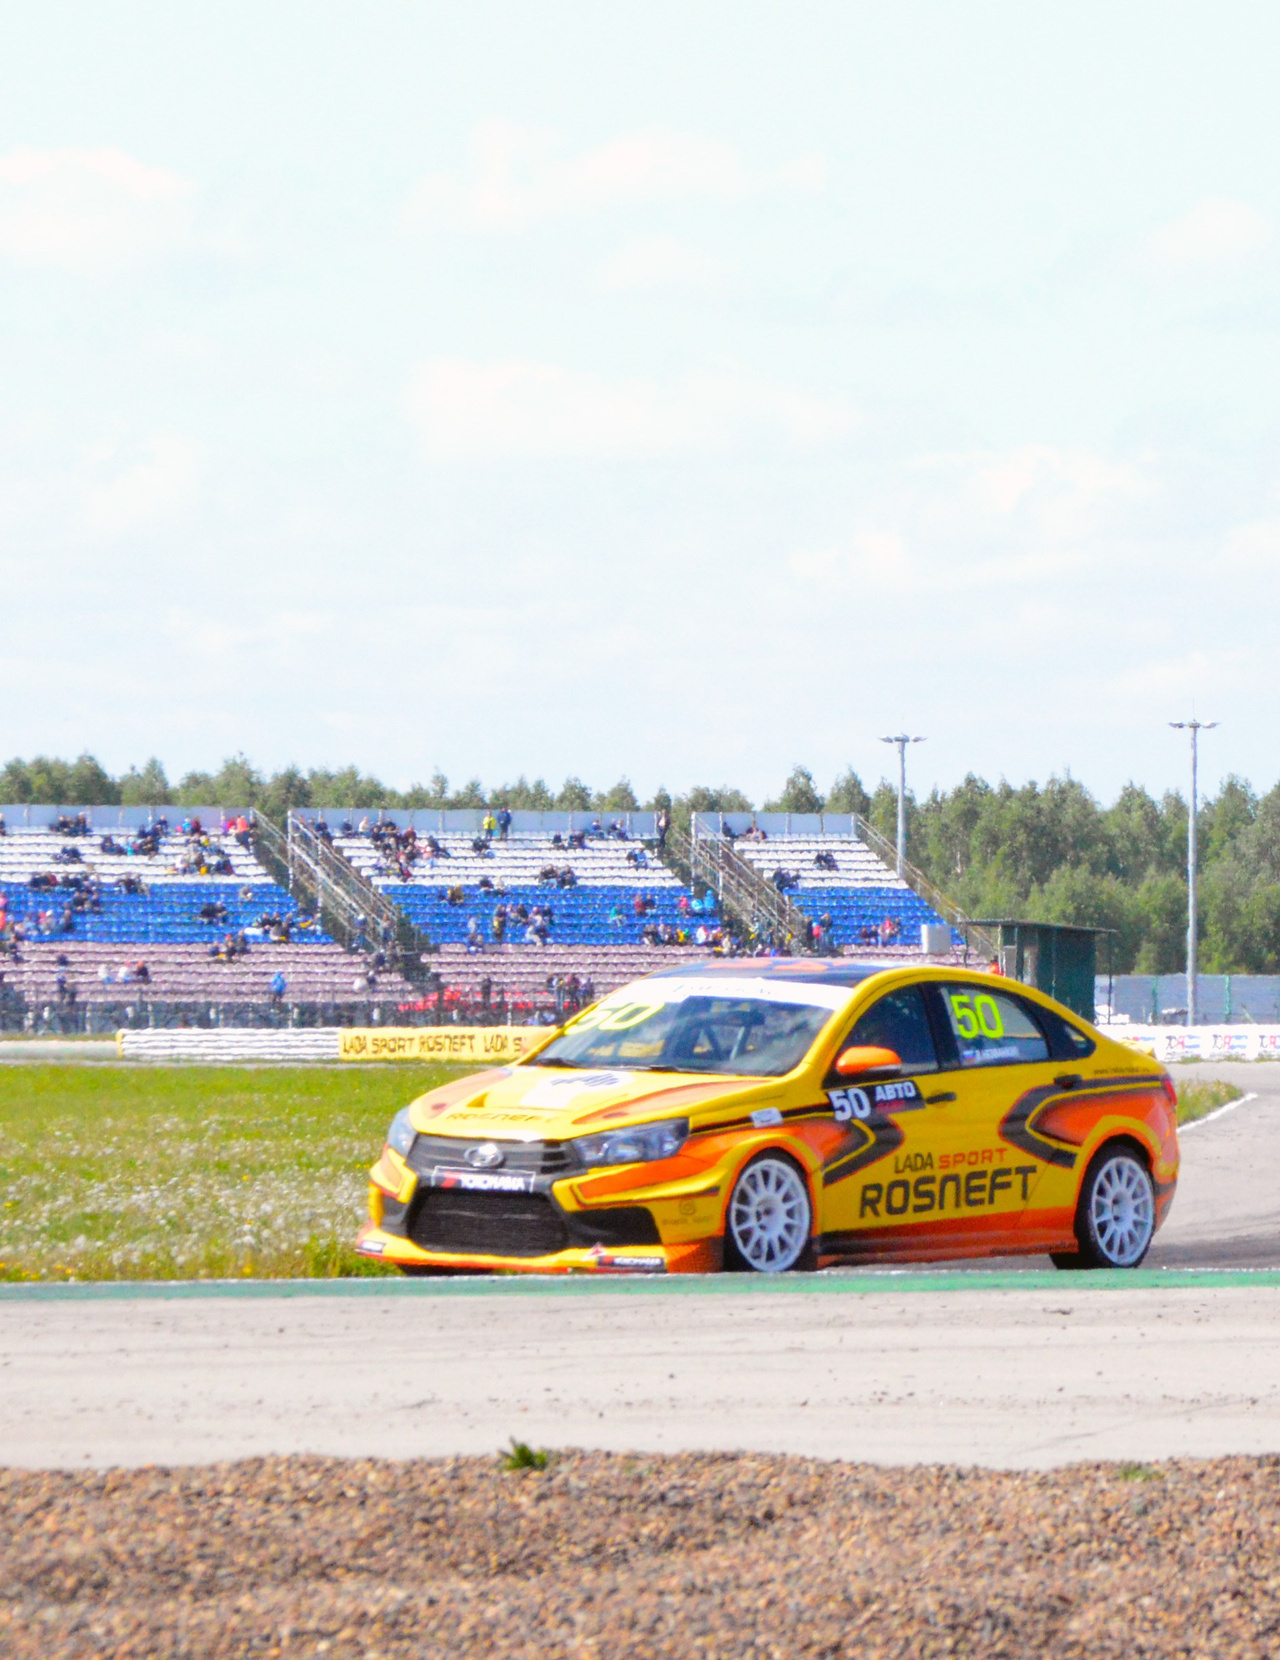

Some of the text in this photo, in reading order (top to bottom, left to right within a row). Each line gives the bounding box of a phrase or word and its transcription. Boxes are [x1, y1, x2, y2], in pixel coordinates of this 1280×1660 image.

[951, 995, 1004, 1039] 50
[343, 1035, 367, 1054] LADA
[371, 1037, 415, 1054] SPORT
[419, 1034, 475, 1053] ROSNEFT
[484, 1034, 508, 1053] LADA
[828, 1081, 917, 1121] 50 АВТО
[894, 1147, 1008, 1174] LADA SPORT
[859, 1164, 1038, 1219] ROSNEFT
